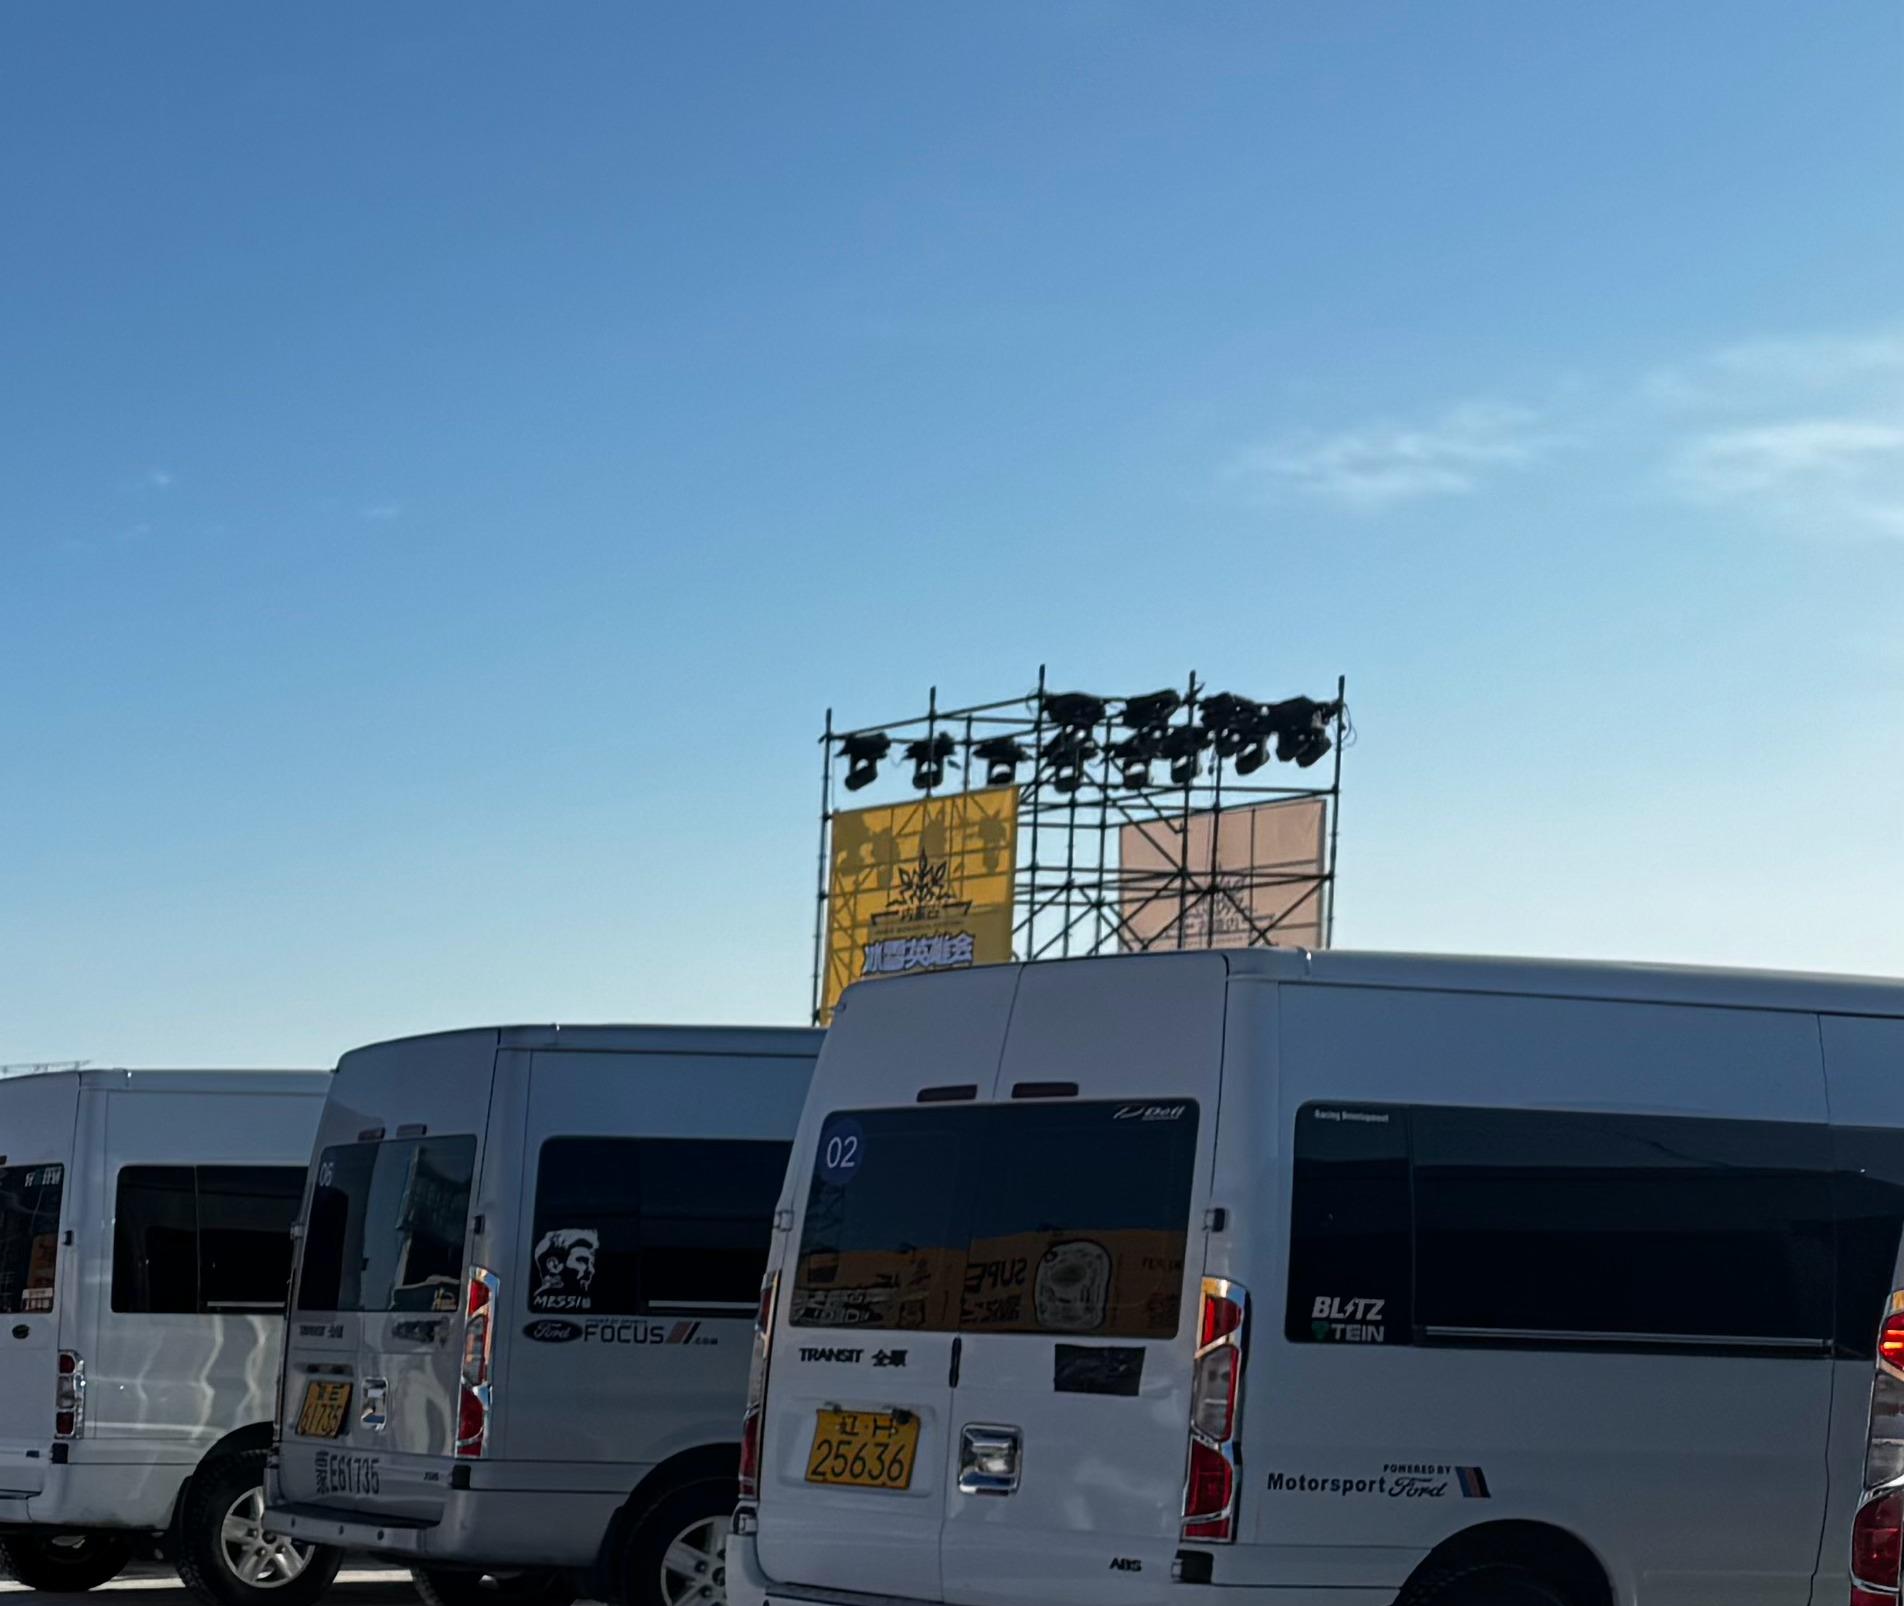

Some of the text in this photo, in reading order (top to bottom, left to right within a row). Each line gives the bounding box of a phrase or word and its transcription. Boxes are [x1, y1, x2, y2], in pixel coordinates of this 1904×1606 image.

[826, 1136, 858, 1169] 02
[1312, 1296, 1385, 1320] BLITZ
[583, 1324, 665, 1344] FOCUS
[1331, 1323, 1385, 1342] TEIN
[799, 1348, 864, 1363] TRANSIT
[811, 1439, 906, 1481] 25636
[1383, 1464, 1451, 1475] POWERED BY
[1267, 1473, 1448, 1497] Motorsport Ford
